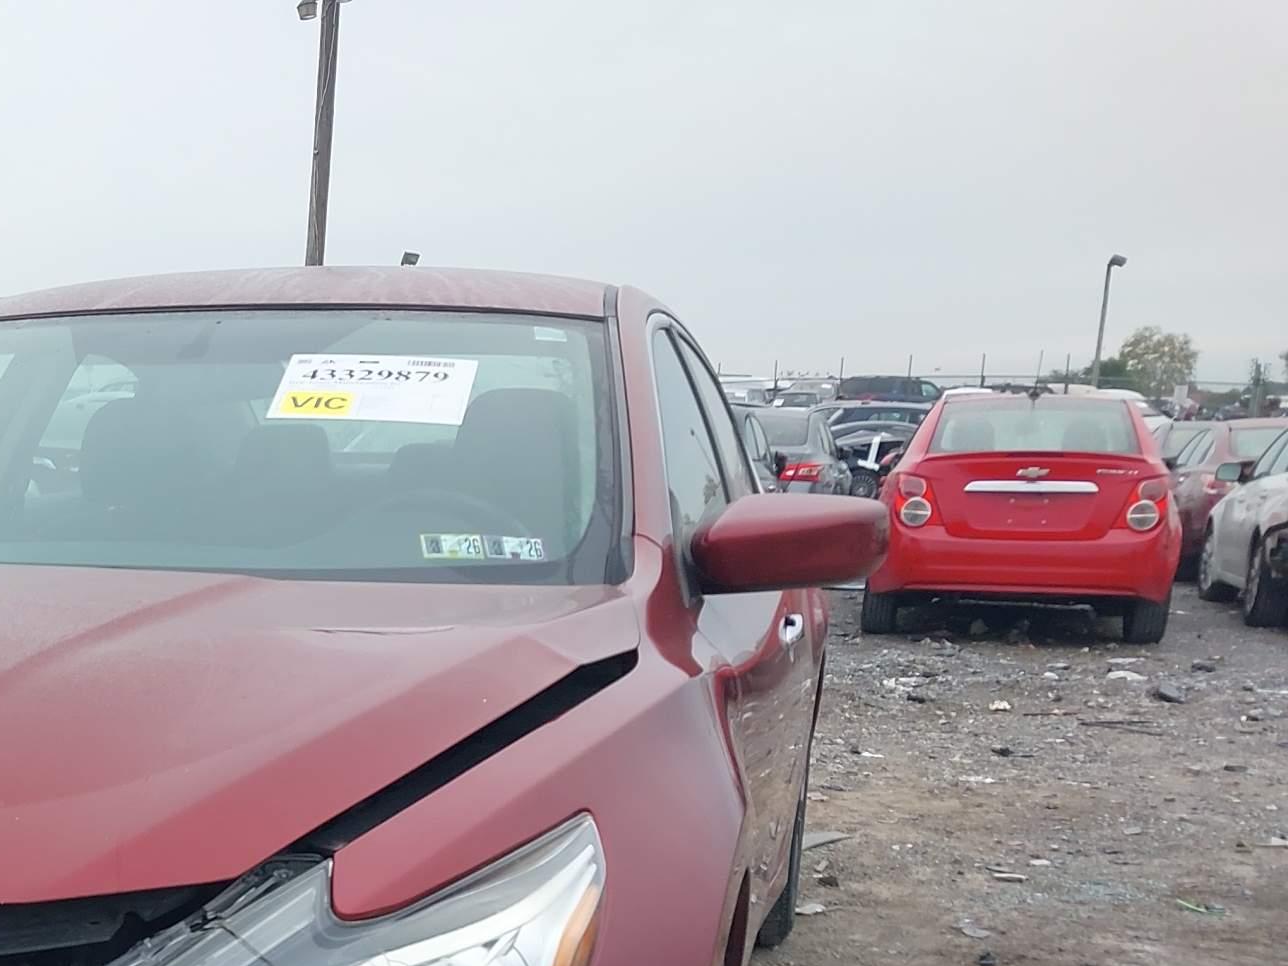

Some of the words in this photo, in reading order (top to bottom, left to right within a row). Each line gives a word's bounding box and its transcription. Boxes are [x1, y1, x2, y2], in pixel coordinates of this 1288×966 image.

[301, 368, 450, 382] 43329879
[290, 396, 348, 410] VIC
[464, 537, 481, 555] 26
[526, 539, 543, 558] 26
